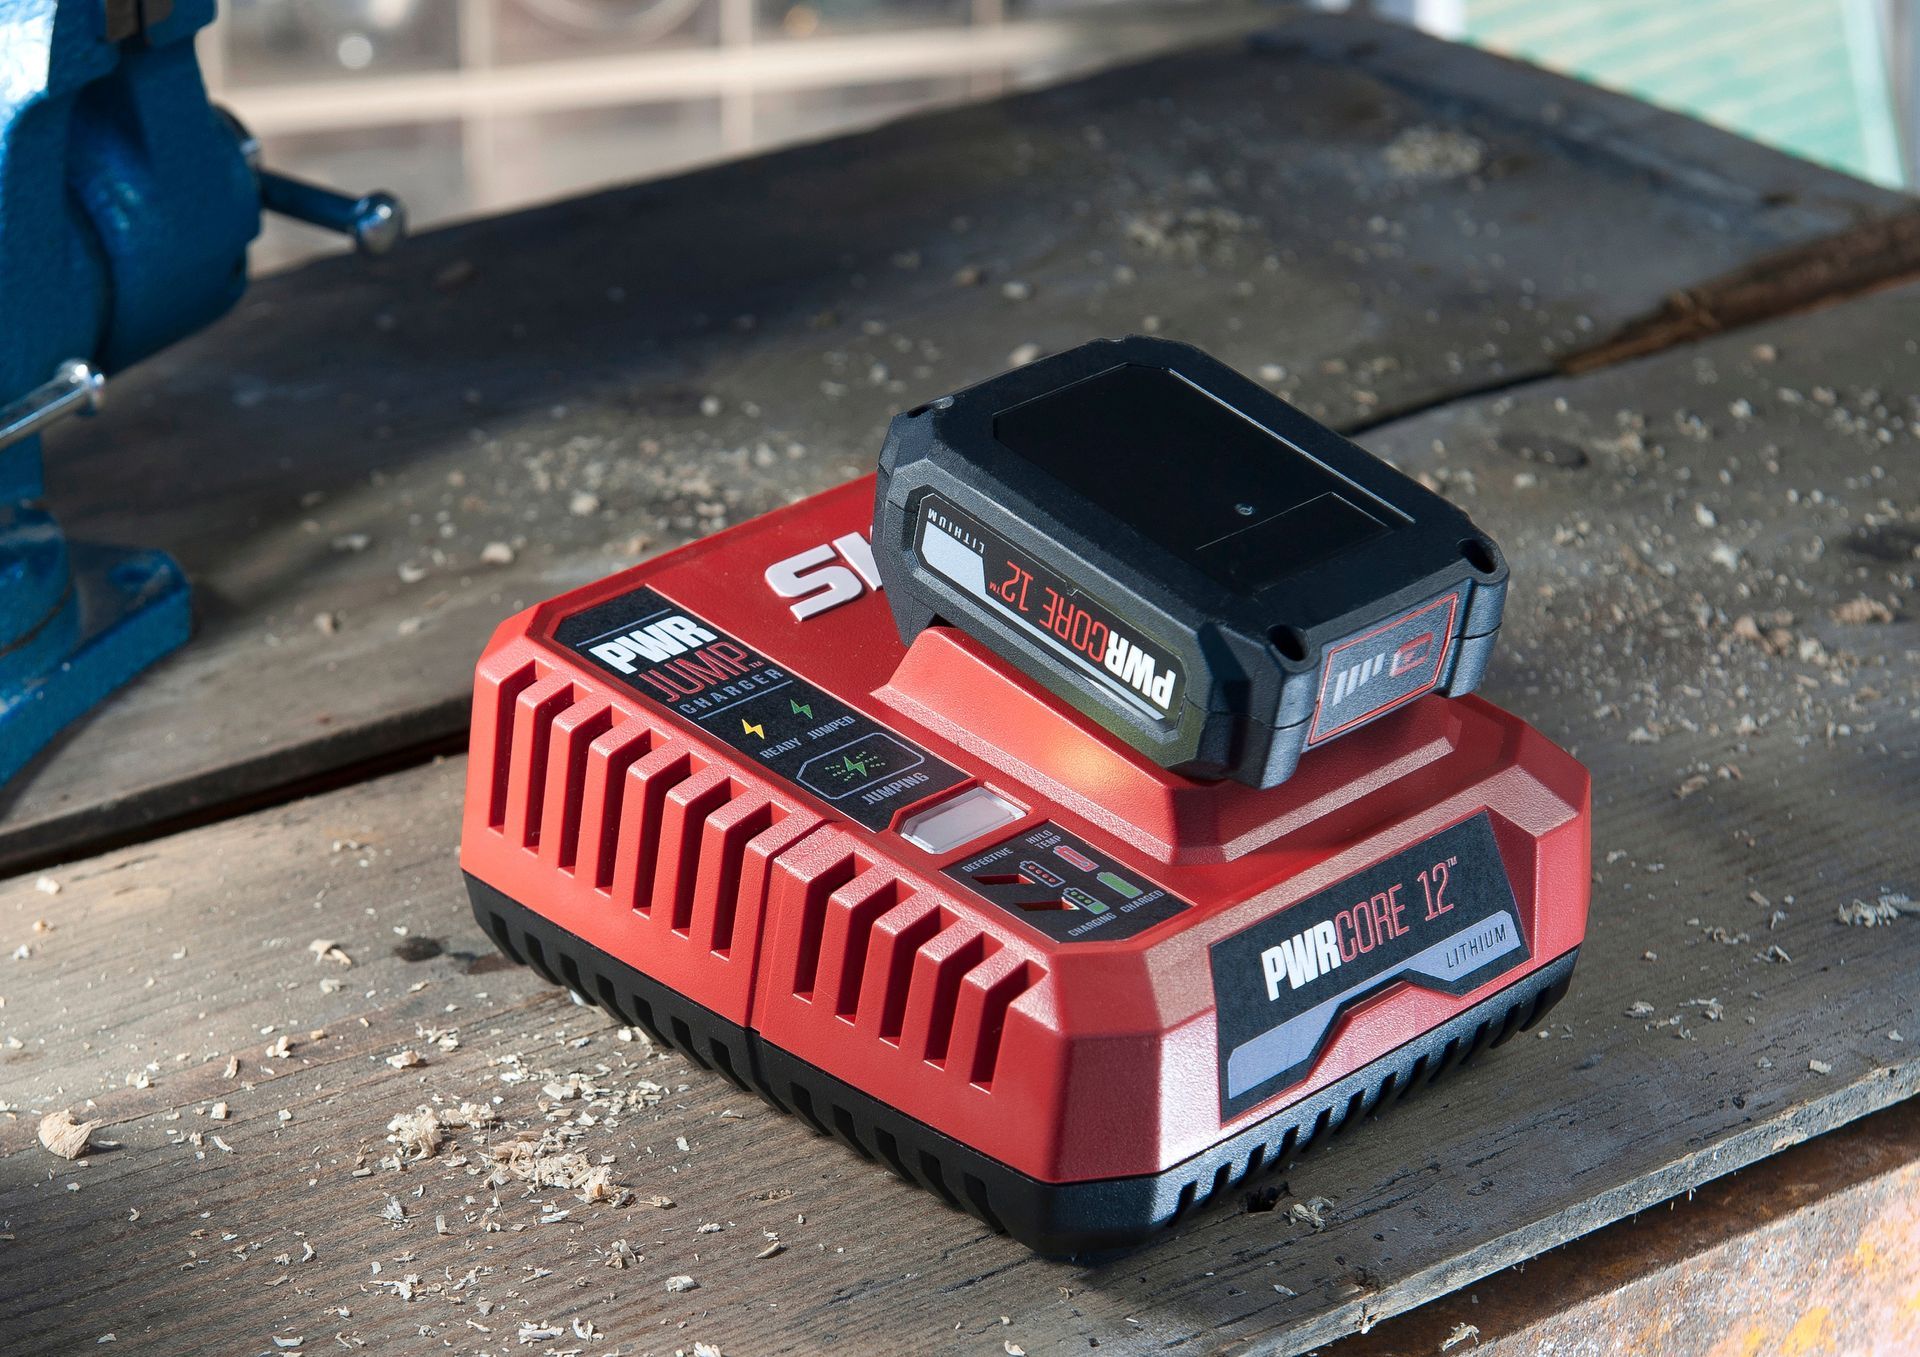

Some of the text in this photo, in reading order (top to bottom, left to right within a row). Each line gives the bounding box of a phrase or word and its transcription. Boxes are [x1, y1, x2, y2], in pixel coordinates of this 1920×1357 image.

[926, 508, 985, 553] LITHIUM
[588, 615, 718, 675] PWR
[1039, 586, 1176, 709] PWRCORE
[679, 667, 784, 715] CHARGER
[759, 715, 856, 759] READY JUMPED
[861, 772, 930, 805] JUMPING
[1025, 829, 1054, 845] HI/LO
[1034, 834, 1062, 850] TEMP
[961, 847, 1015, 873] DEFECTIVE
[1119, 889, 1166, 914] CHARGED
[1067, 912, 1118, 937] CHARGING
[1261, 883, 1410, 1002] PWRCORE
[1446, 924, 1507, 968] LITHIUM
